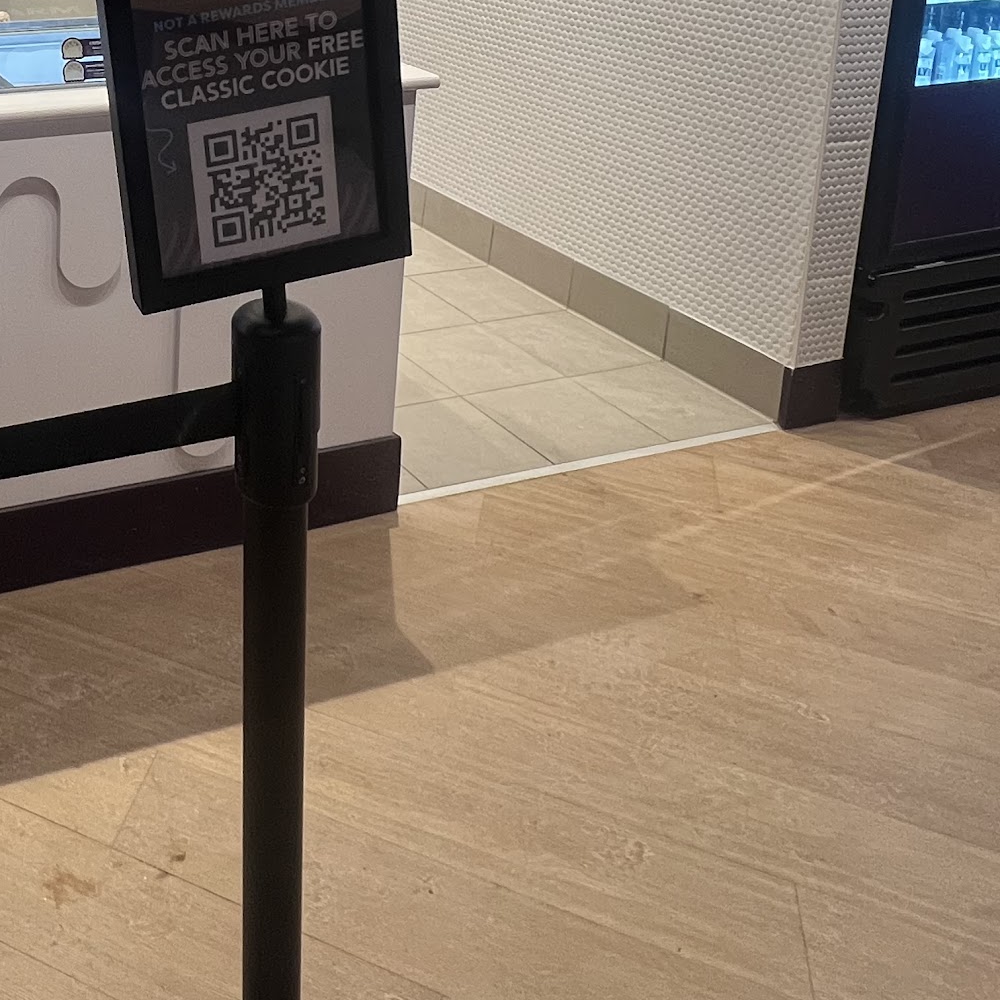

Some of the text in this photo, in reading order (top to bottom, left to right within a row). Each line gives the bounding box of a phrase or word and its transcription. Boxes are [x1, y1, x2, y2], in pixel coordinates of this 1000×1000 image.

[153, 15, 184, 33] NOT
[187, 14, 198, 26] A
[201, 0, 272, 24] REWARDS
[164, 10, 338, 61] SCAN HERE TO
[141, 29, 365, 90] ACCESS YOUR FREE
[160, 56, 350, 110] CLASSIC COOKIE
